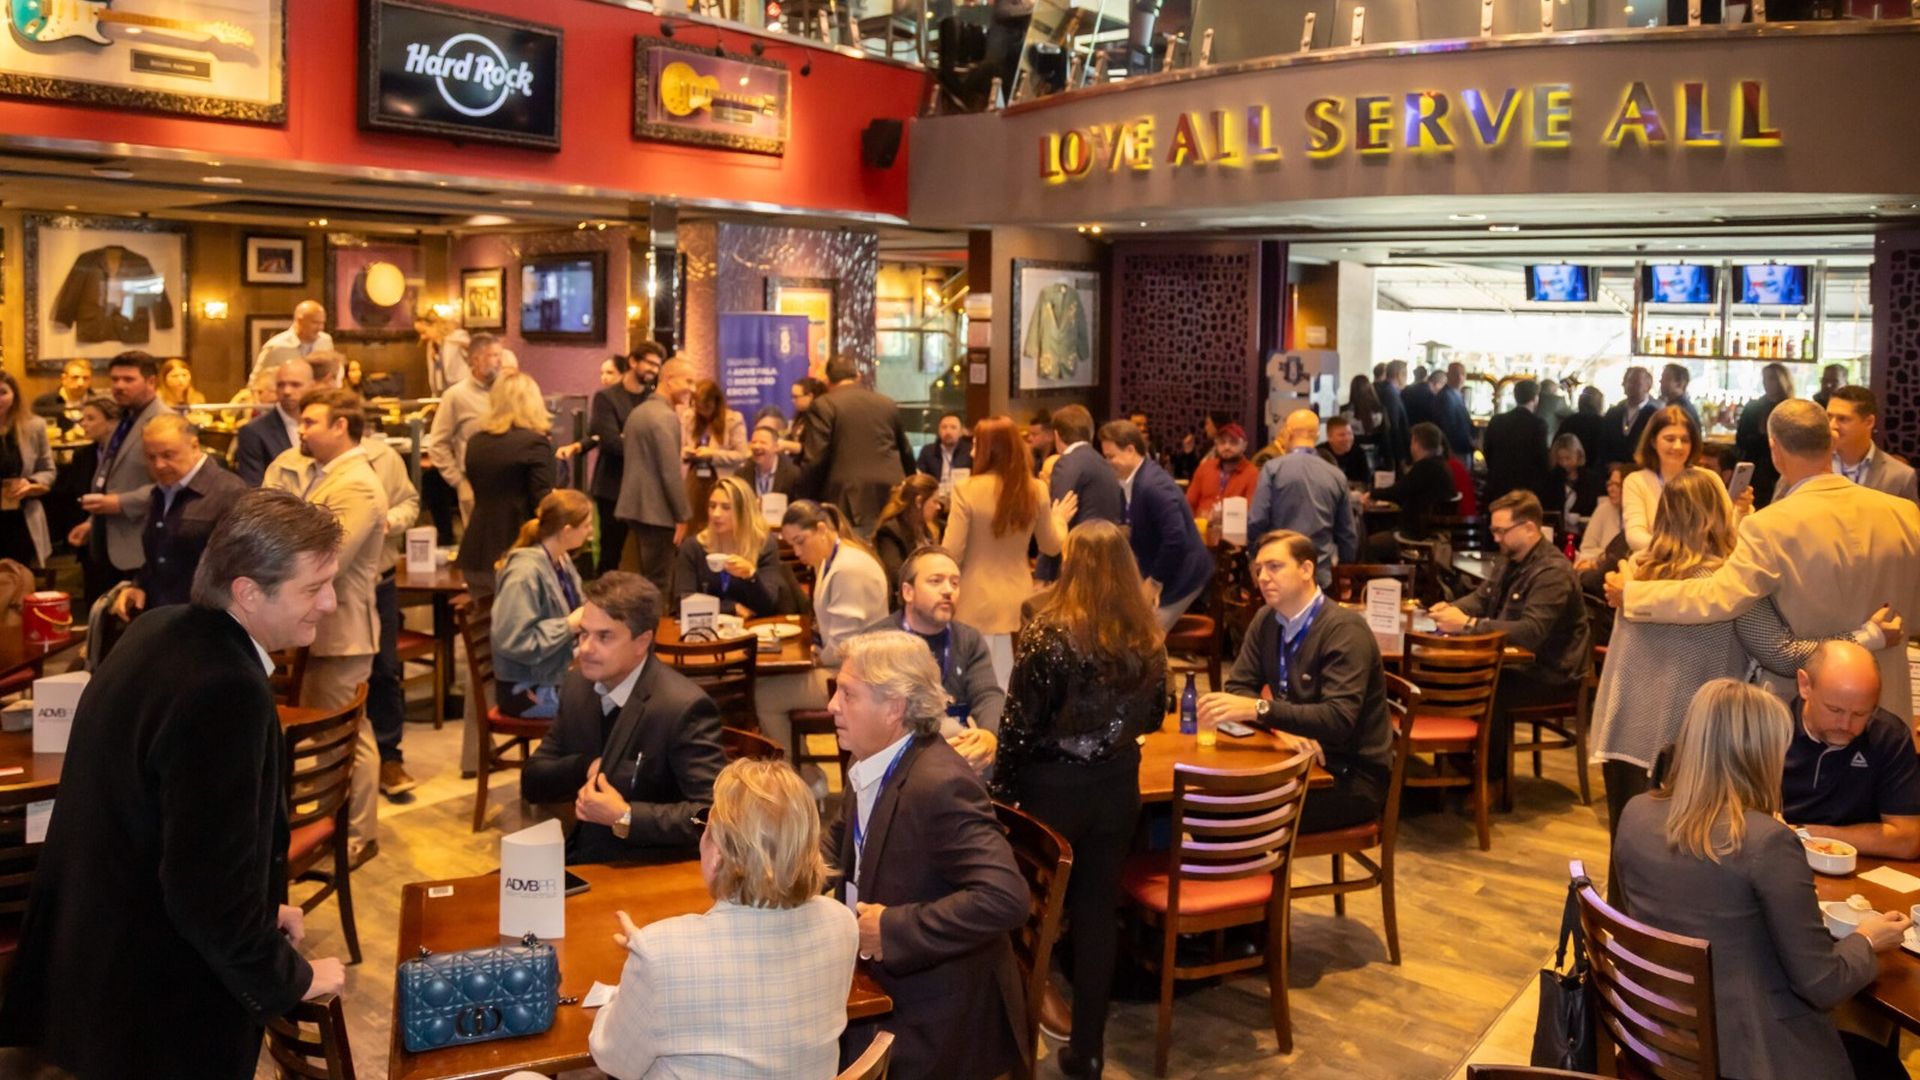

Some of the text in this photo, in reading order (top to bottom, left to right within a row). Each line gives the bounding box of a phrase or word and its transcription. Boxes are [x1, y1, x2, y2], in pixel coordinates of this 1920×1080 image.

[405, 43, 534, 96] Hard Rock
[1040, 81, 1782, 180] LOVE ALL SERVE ALL
